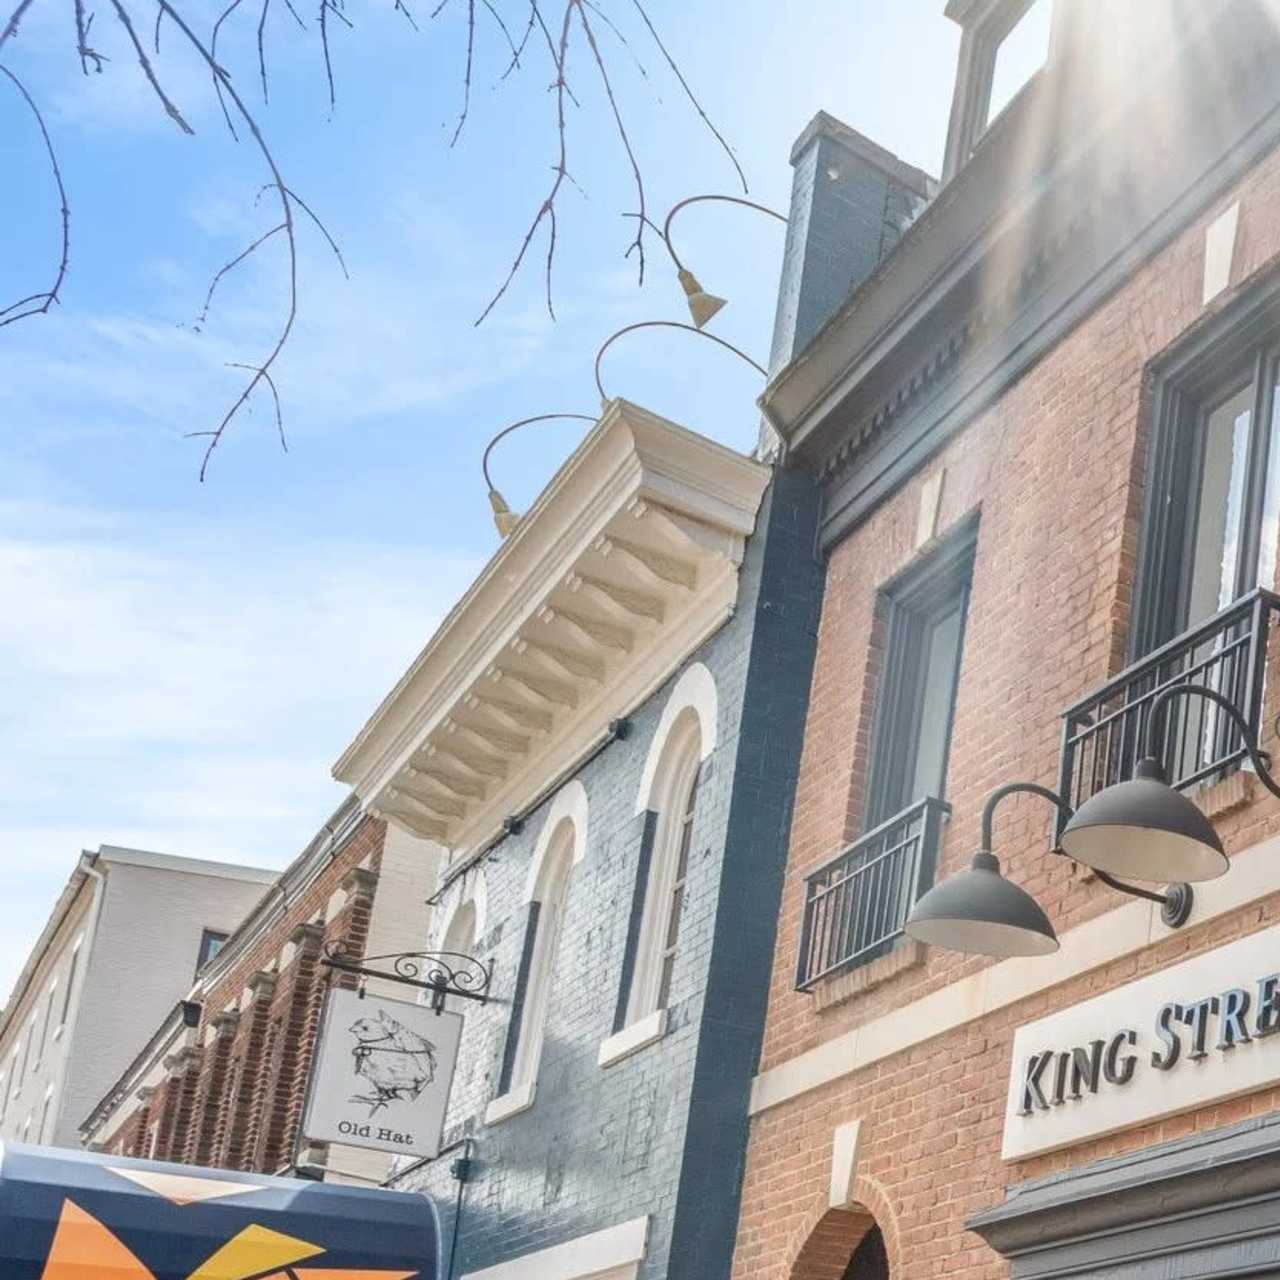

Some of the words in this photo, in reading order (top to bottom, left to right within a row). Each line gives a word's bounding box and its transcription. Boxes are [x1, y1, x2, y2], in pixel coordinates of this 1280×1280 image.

[1016, 1028, 1138, 1117] KING
[337, 1120, 371, 1138] Old
[375, 1127, 415, 1145] Hat
